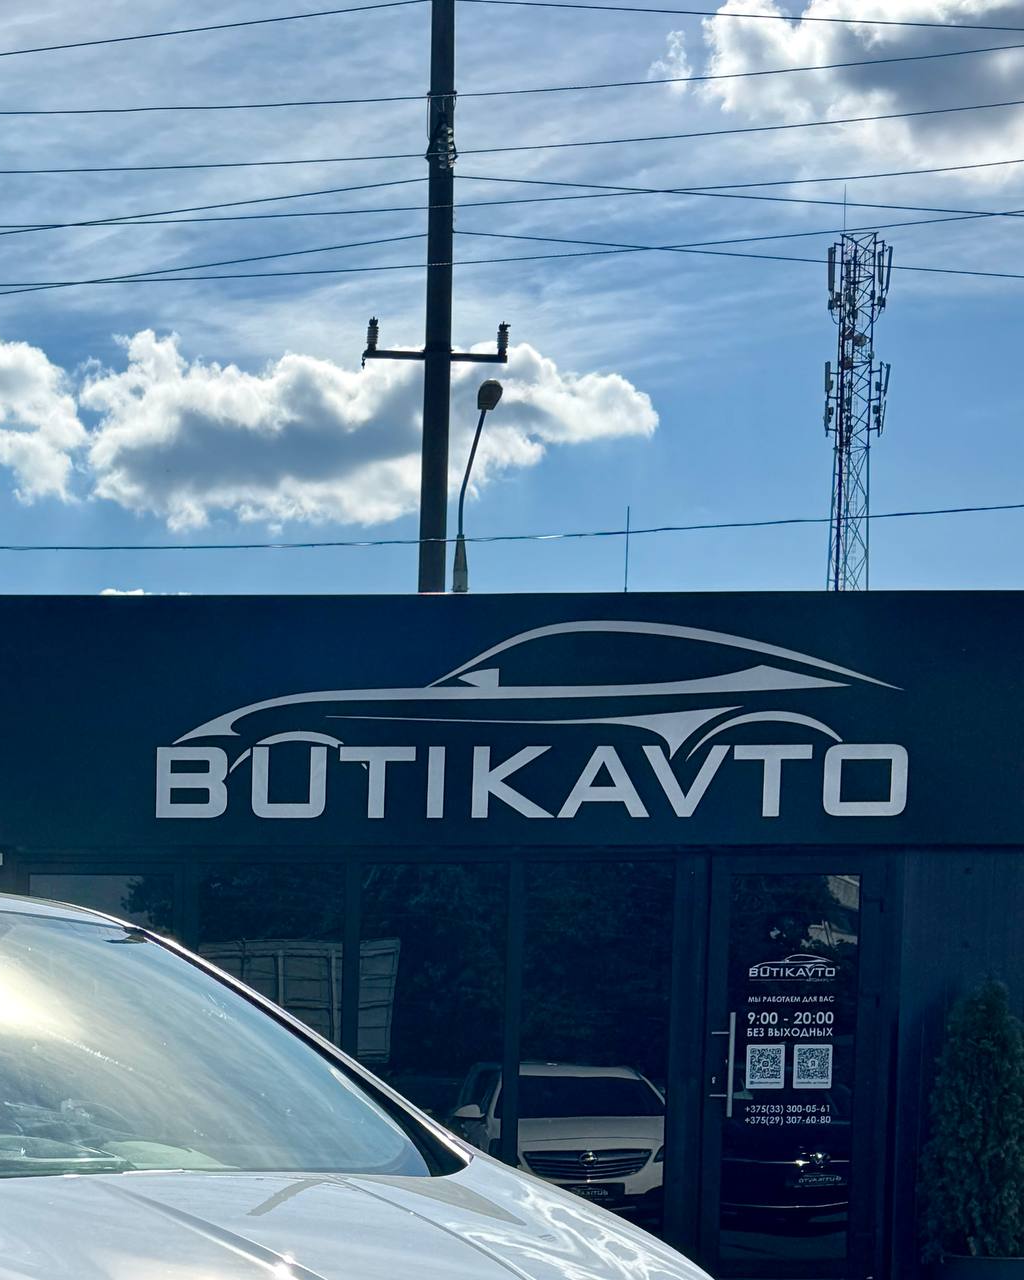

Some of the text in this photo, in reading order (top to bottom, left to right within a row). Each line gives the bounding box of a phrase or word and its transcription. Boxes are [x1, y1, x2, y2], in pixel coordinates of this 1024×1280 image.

[155, 742, 909, 819] BUTIKAVTO
[749, 967, 836, 977] BUTIKAVTO
[748, 995, 835, 1003] МЫ РАБОТАЕМ ДЛЯ ВАС
[747, 1012, 778, 1025] 9:00
[793, 1011, 835, 1025] 20:00
[747, 1027, 833, 1038] БЕЗ ВЫХОДНЫХ
[745, 1105, 831, 1114] +375(33) 300-05-61
[745, 1115, 832, 1126] +375(29) 307-60-80
